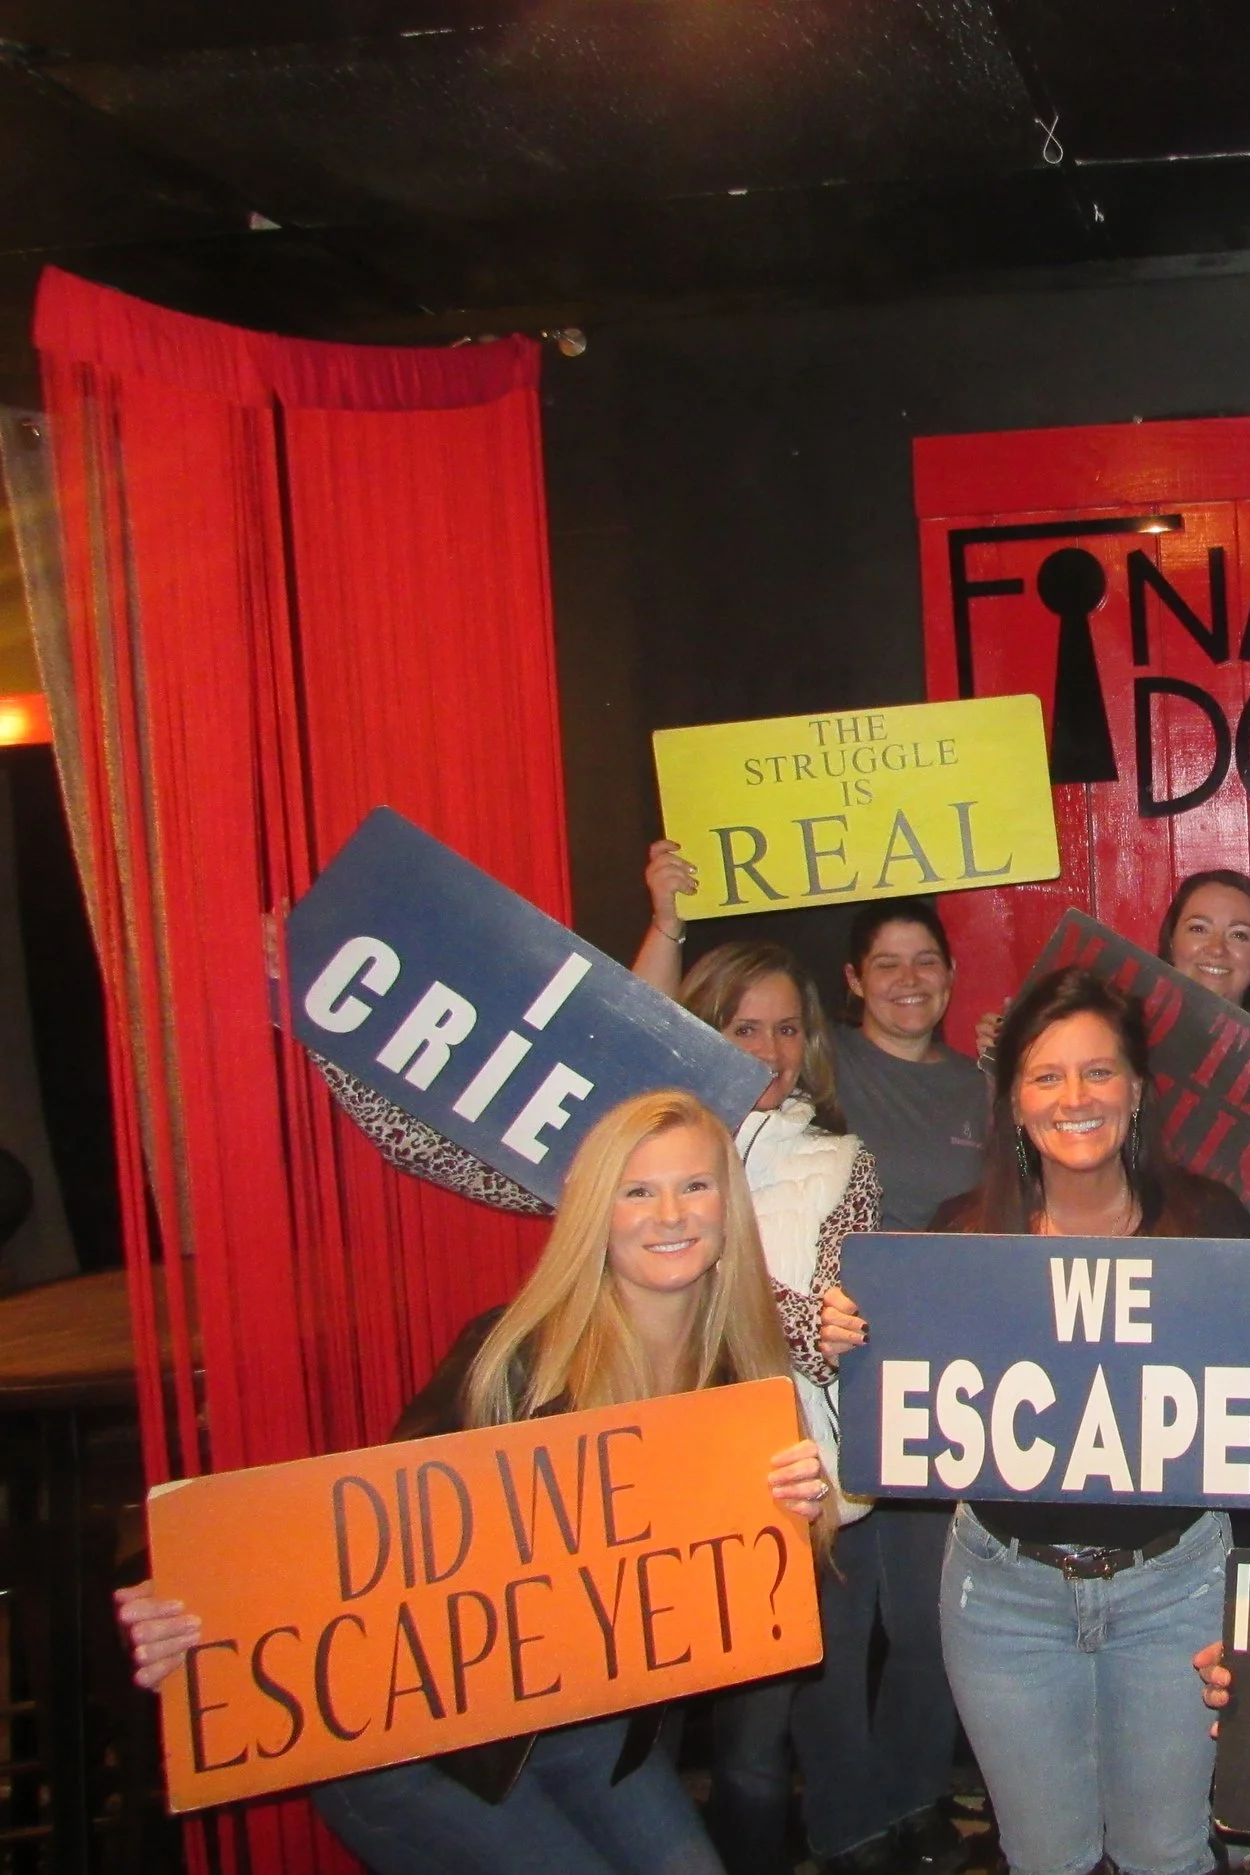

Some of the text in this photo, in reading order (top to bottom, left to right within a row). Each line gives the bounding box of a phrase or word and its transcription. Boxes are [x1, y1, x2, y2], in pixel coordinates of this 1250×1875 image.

[744, 739, 959, 786] STRUGGLE
[809, 714, 888, 746] THE
[841, 779, 874, 807] IS
[709, 801, 1013, 907] REAL
[523, 952, 592, 1031] I
[305, 936, 595, 1165] CRIE
[1050, 1257, 1152, 1344] WE
[332, 1426, 652, 1602] DID WE
[185, 1525, 787, 1774] ESCAPE YET?
